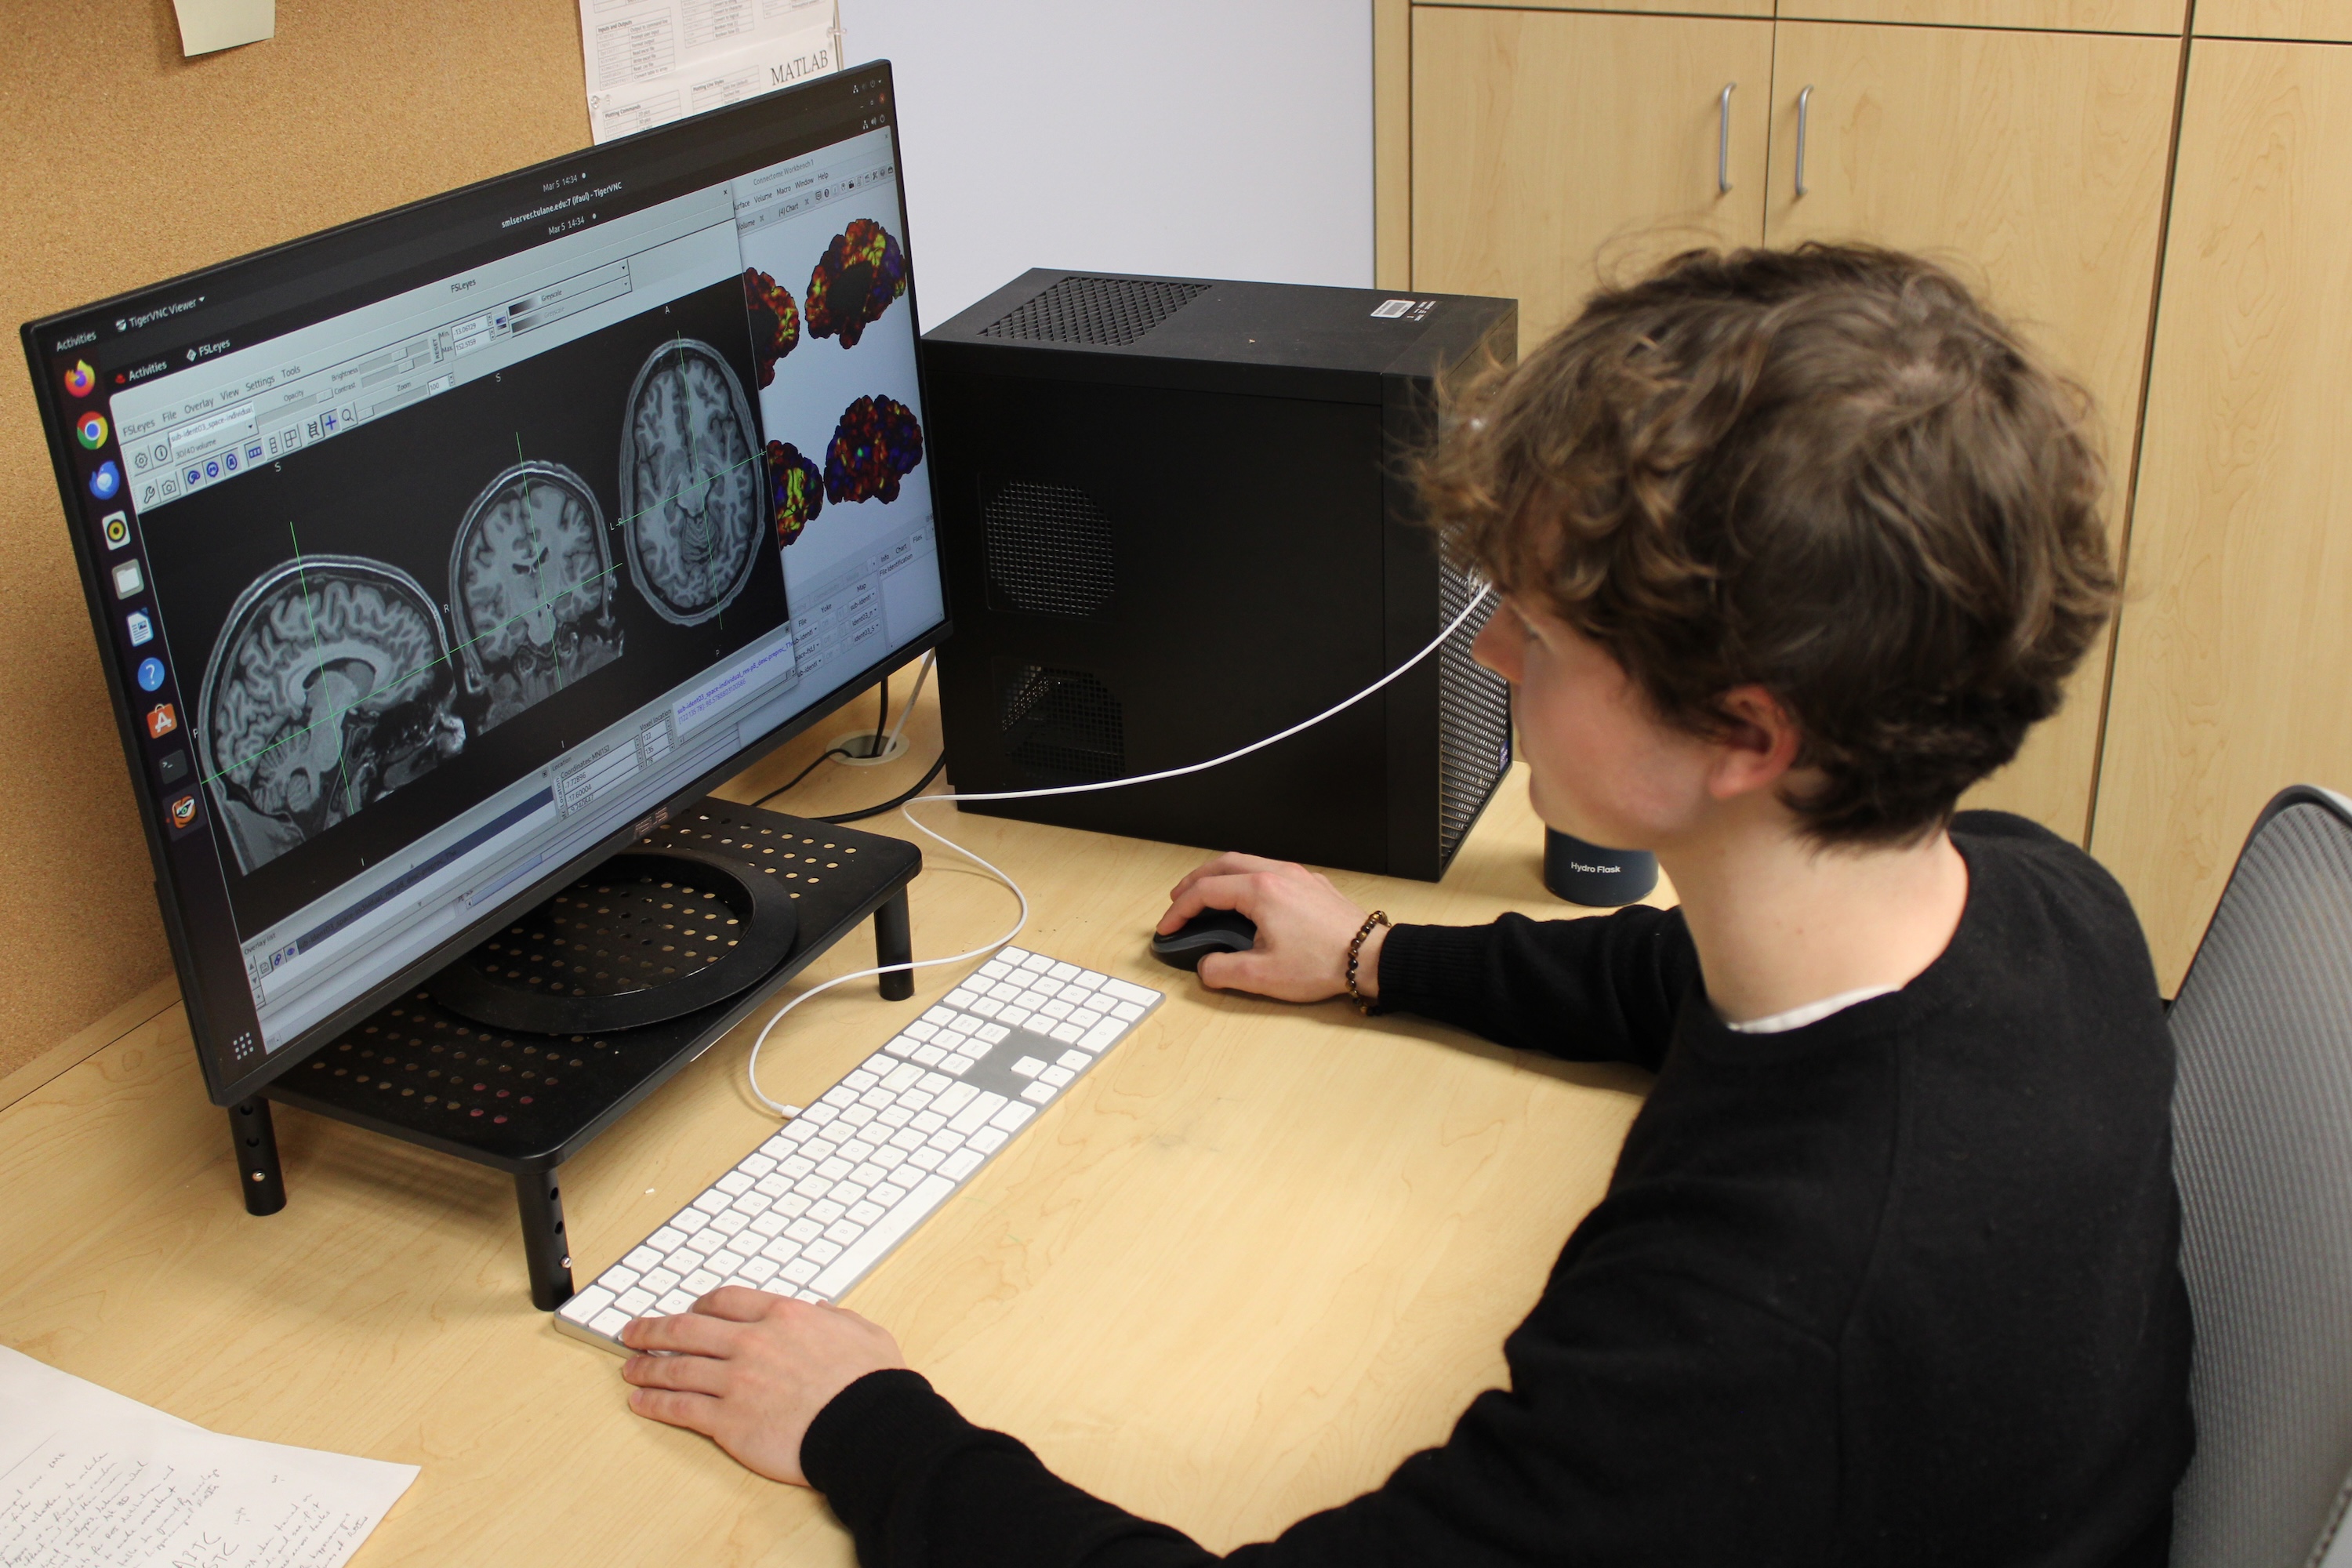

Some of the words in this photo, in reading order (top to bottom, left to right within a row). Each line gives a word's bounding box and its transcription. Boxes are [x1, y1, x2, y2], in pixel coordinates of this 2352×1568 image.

[771, 49, 828, 86] MATLAB
[753, 172, 783, 186] Connectome
[784, 162, 810, 175] Workbench
[818, 172, 829, 181] Help
[543, 183, 554, 192] Mar
[562, 174, 578, 186] 14:34
[795, 177, 815, 189] Window
[776, 186, 792, 196] Macro
[753, 192, 772, 204] Volume
[502, 198, 571, 228] smlserver.tulane.edu:7
[593, 182, 622, 198] TigerVNC
[735, 201, 750, 211] urface
[786, 203, 799, 213] Chart
[549, 225, 561, 235] Mar
[561, 222, 566, 230] 5
[568, 216, 585, 229] 14:34
[451, 278, 477, 293] FSLeyes
[541, 289, 562, 302] Greyscale
[129, 307, 168, 328] TigerVNC
[169, 298, 196, 314] Viewer
[664, 306, 670, 315] A
[56, 331, 96, 352] Activities
[198, 339, 230, 358] FSLeyes
[129, 361, 167, 381] Activities
[282, 366, 301, 379] Tools
[332, 367, 358, 382] Brightness
[245, 375, 275, 392] Settings
[495, 374, 502, 383] S
[334, 382, 356, 395] Contrast
[397, 382, 412, 392] Zoom
[430, 382, 440, 390] 100
[220, 388, 240, 401] View
[284, 390, 304, 402] Opacity
[184, 397, 214, 414] Overlay
[162, 410, 177, 423] File
[123, 419, 155, 437] FSLeyes
[176, 446, 196, 459] 3D/4D
[196, 437, 216, 452] volume
[274, 462, 281, 473] S
[913, 534, 923, 543] Files
[895, 543, 907, 554] Chart
[880, 554, 890, 563] Info
[887, 553, 913, 573] Identification
[857, 583, 867, 592] Map
[443, 604, 450, 613] R
[821, 604, 832, 614] Yoke
[640, 720, 653, 731] Voxel
[653, 709, 672, 724] location
[193, 728, 198, 739] P
[643, 732, 652, 741] 122
[645, 746, 655, 755] 135
[552, 756, 572, 771] Location
[561, 759, 592, 779] Coordinates:
[592, 745, 610, 761] MNI152
[633, 806, 669, 840] ASUS
[1570, 862, 1596, 873] Hydro
[1597, 866, 1621, 874] Flask
[244, 938, 267, 956] Overlay
[267, 933, 276, 942] list
